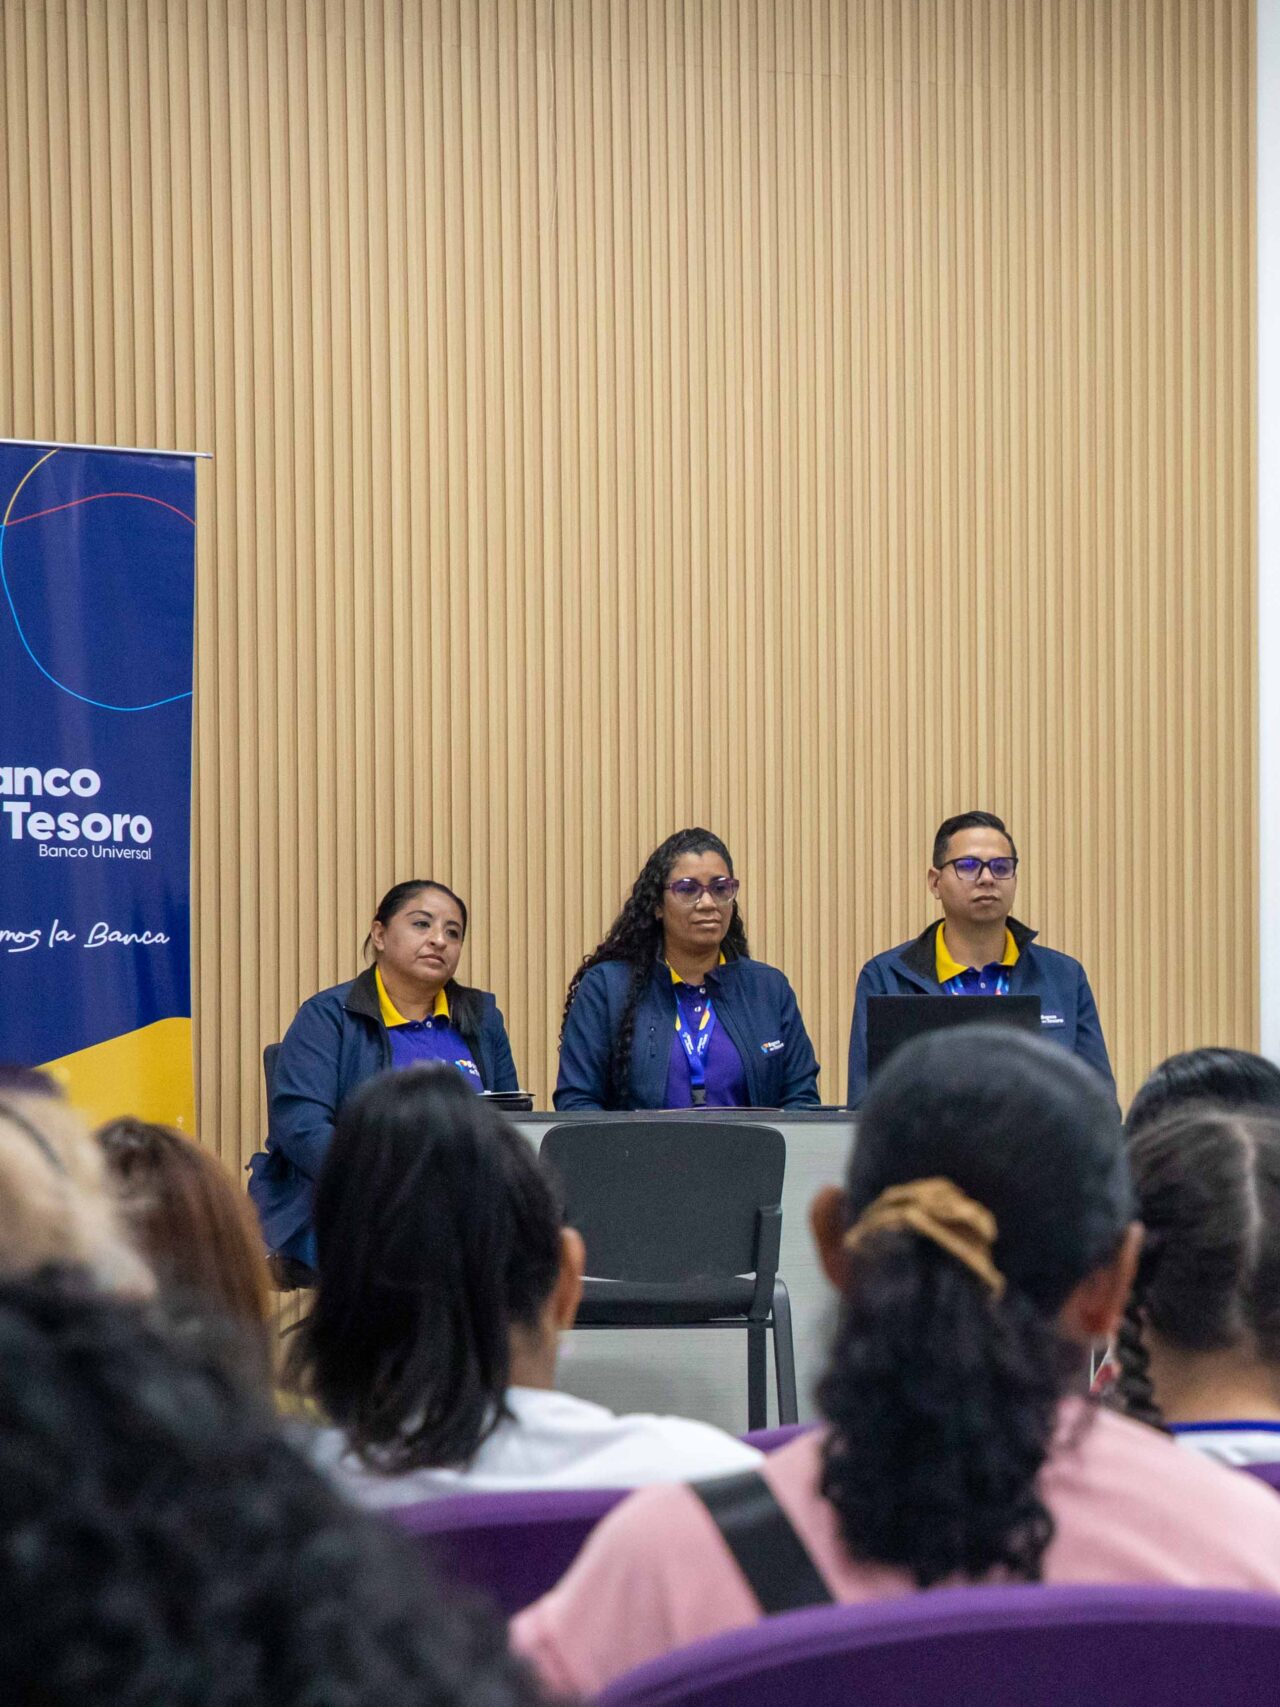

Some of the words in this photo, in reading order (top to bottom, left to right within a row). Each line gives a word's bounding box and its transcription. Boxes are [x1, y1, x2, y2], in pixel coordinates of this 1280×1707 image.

[3, 801, 153, 844] Tesoro
[39, 844, 88, 858] Banco
[91, 845, 152, 861] Universal
[49, 918, 76, 948] la
[83, 921, 170, 948] Banca
